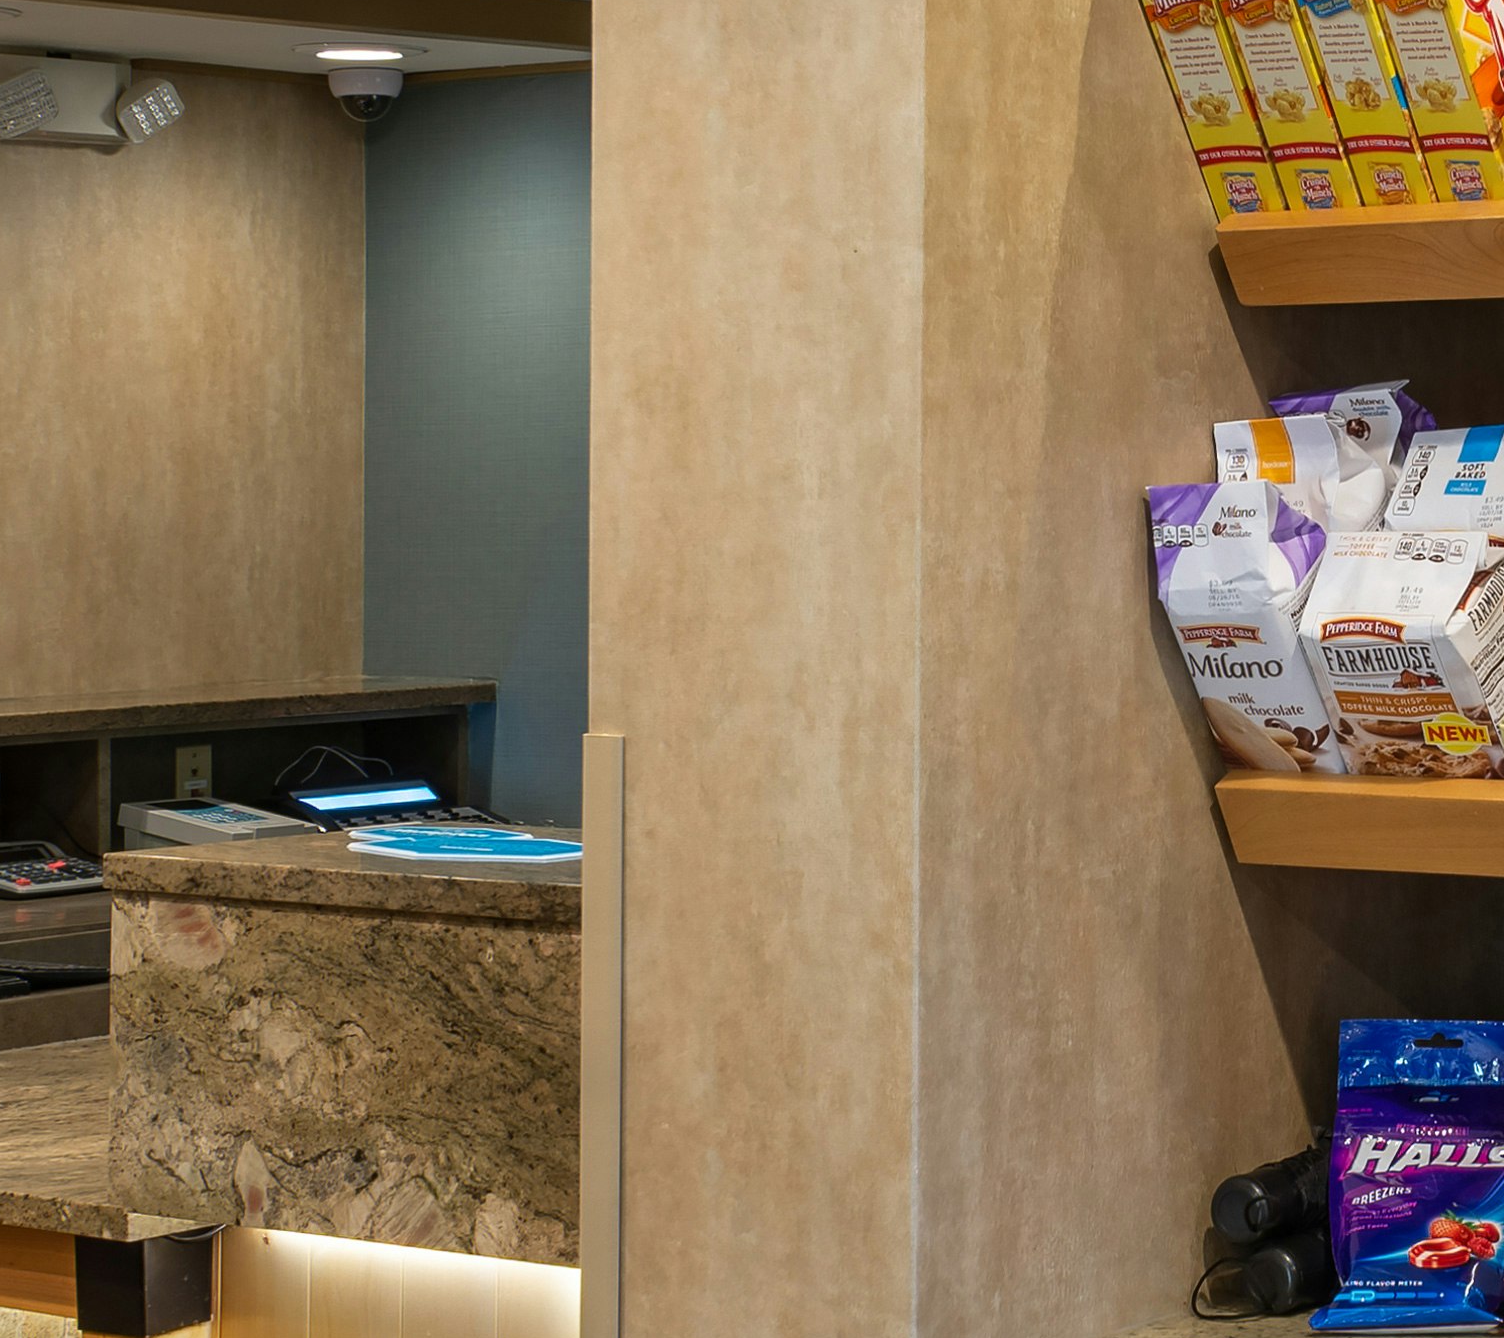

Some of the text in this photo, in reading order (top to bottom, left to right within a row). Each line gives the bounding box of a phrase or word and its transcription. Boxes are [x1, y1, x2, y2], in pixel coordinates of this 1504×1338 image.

[1455, 470, 1486, 480] BAKED
[1461, 463, 1485, 473] SOFT
[1220, 506, 1257, 520] Milano
[1183, 626, 1256, 640] PEPPERIDGE FARM
[1325, 622, 1399, 638] PEPPERIDGE FARM
[1187, 651, 1282, 680] Milano
[1321, 646, 1436, 674] FARMHOUSE
[1228, 693, 1256, 705] milk
[1360, 694, 1429, 706] THIN CRISPY
[1244, 702, 1305, 717] chocolate
[1341, 702, 1454, 714] TOFFEE MILK CHOCOLATE
[1427, 725, 1487, 744] NEW!
